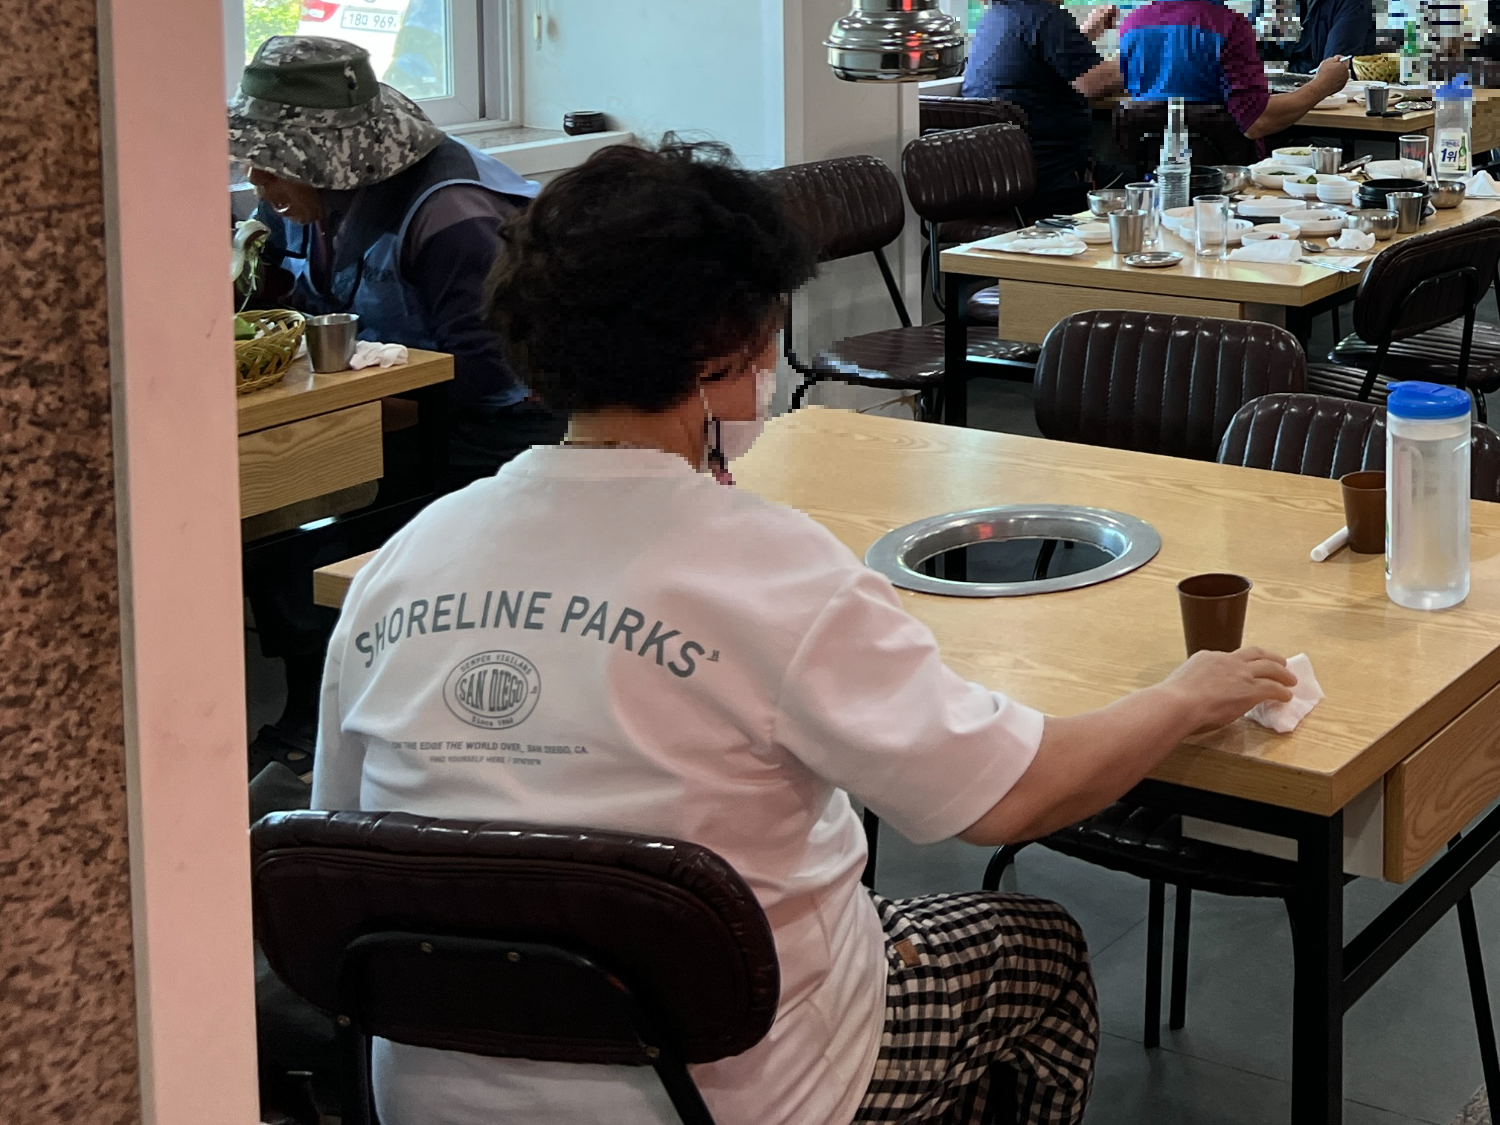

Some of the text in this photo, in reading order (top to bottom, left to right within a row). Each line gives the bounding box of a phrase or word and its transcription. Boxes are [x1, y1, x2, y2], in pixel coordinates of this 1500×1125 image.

[373, 15, 397, 29] 969
[1441, 148, 1457, 162] 1위
[355, 590, 706, 678] SHORELINE PARKS
[459, 668, 524, 712] SAN DIEGO
[419, 741, 443, 750] EDGE
[446, 741, 464, 750] THE
[465, 741, 498, 751] WORLD
